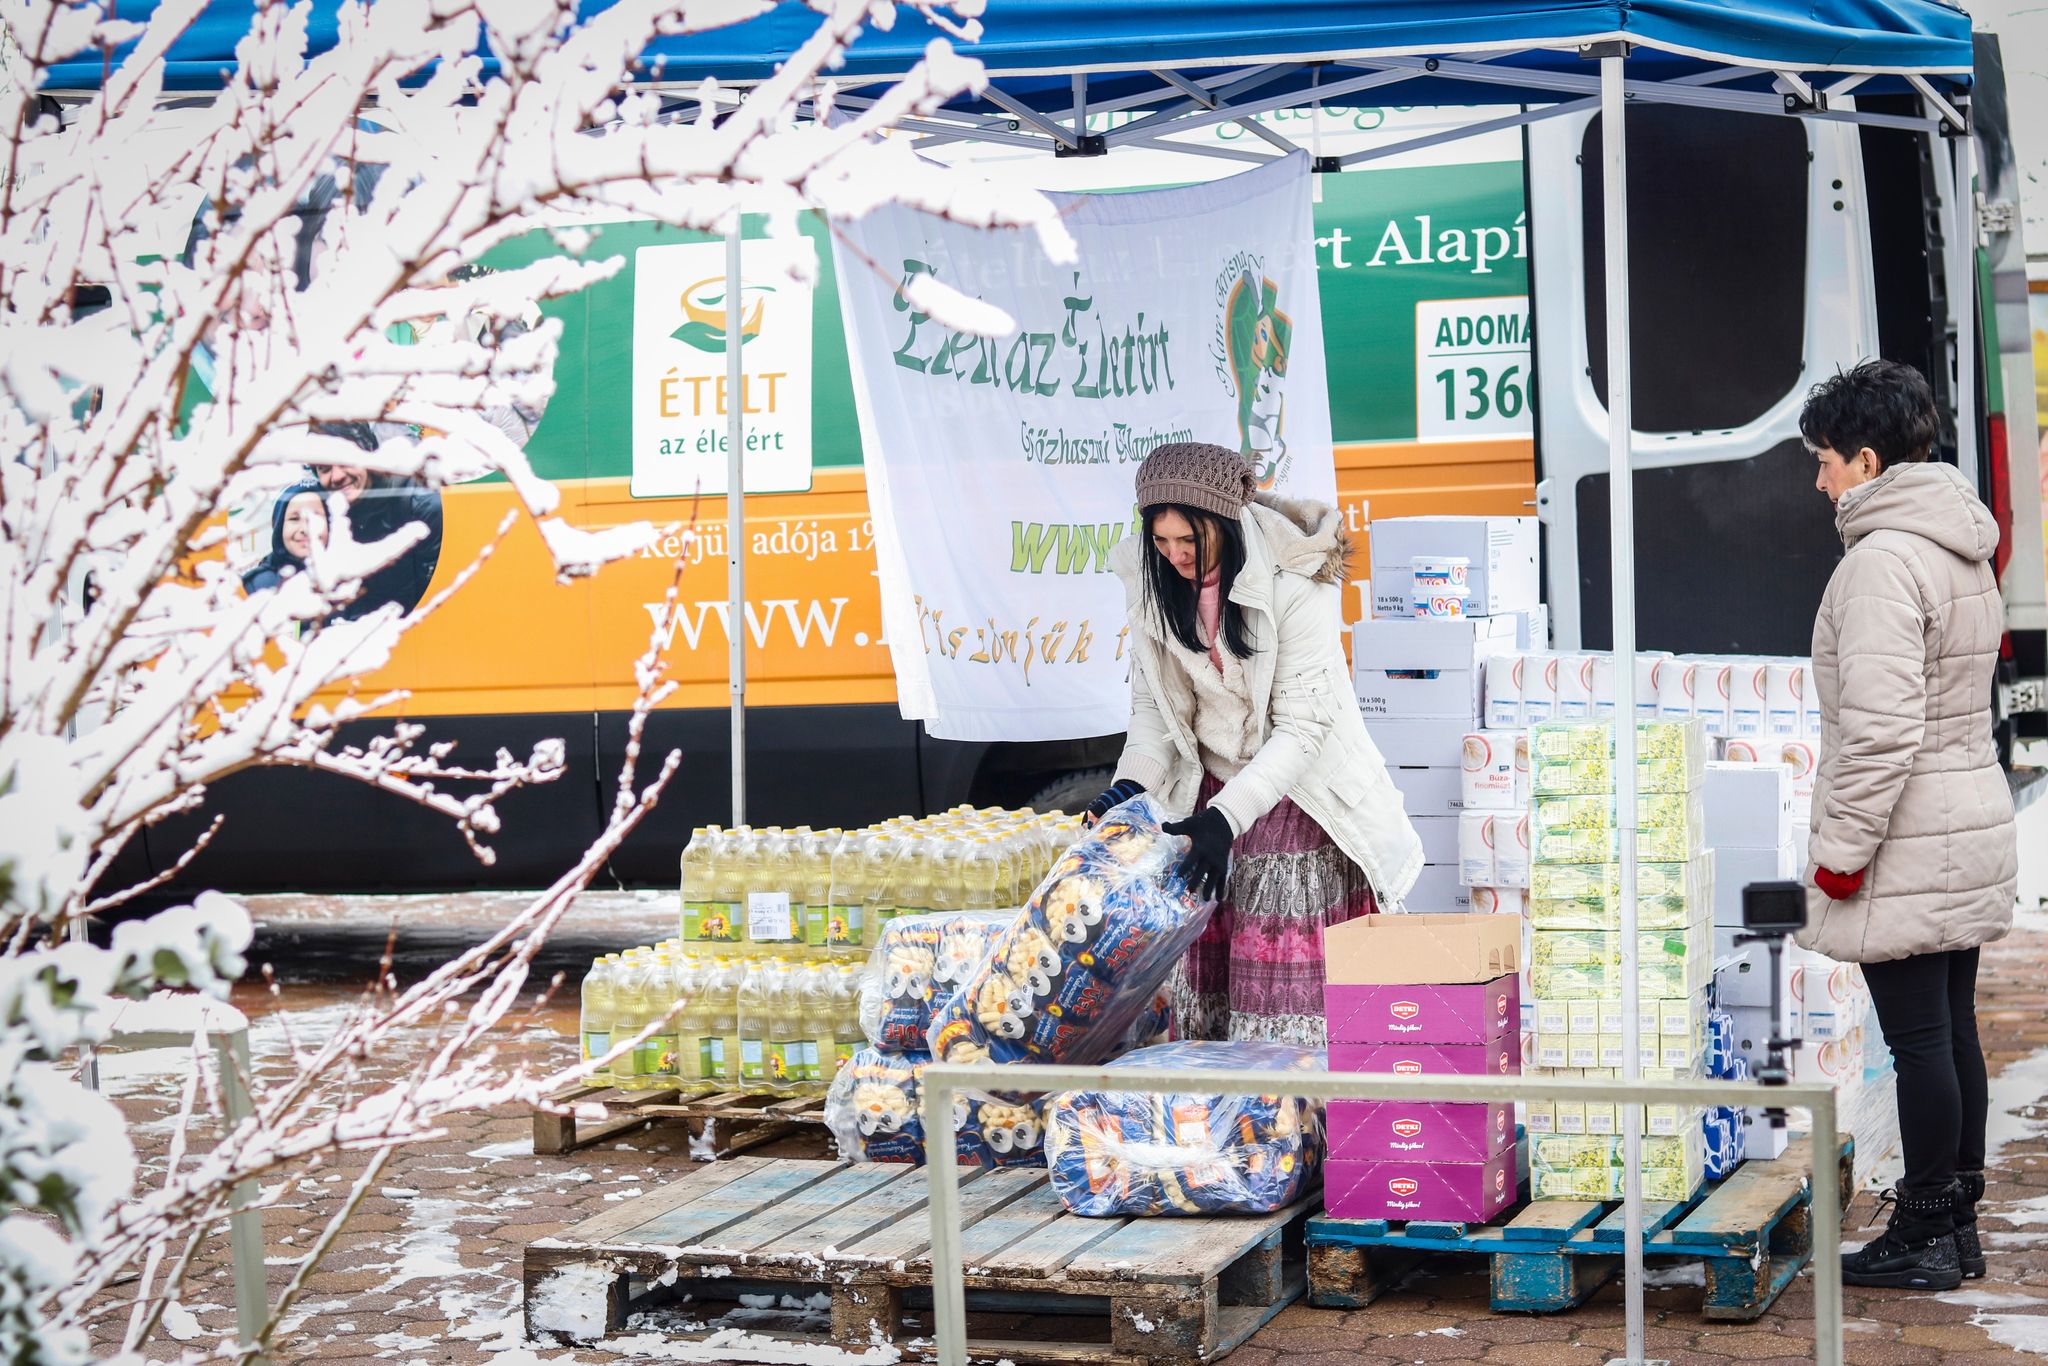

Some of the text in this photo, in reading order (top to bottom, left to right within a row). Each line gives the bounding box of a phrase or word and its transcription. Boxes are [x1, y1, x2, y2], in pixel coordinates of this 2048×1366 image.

[1004, 331, 1061, 398] az
[659, 427, 784, 455] az éleért
[752, 521, 838, 560] adója
